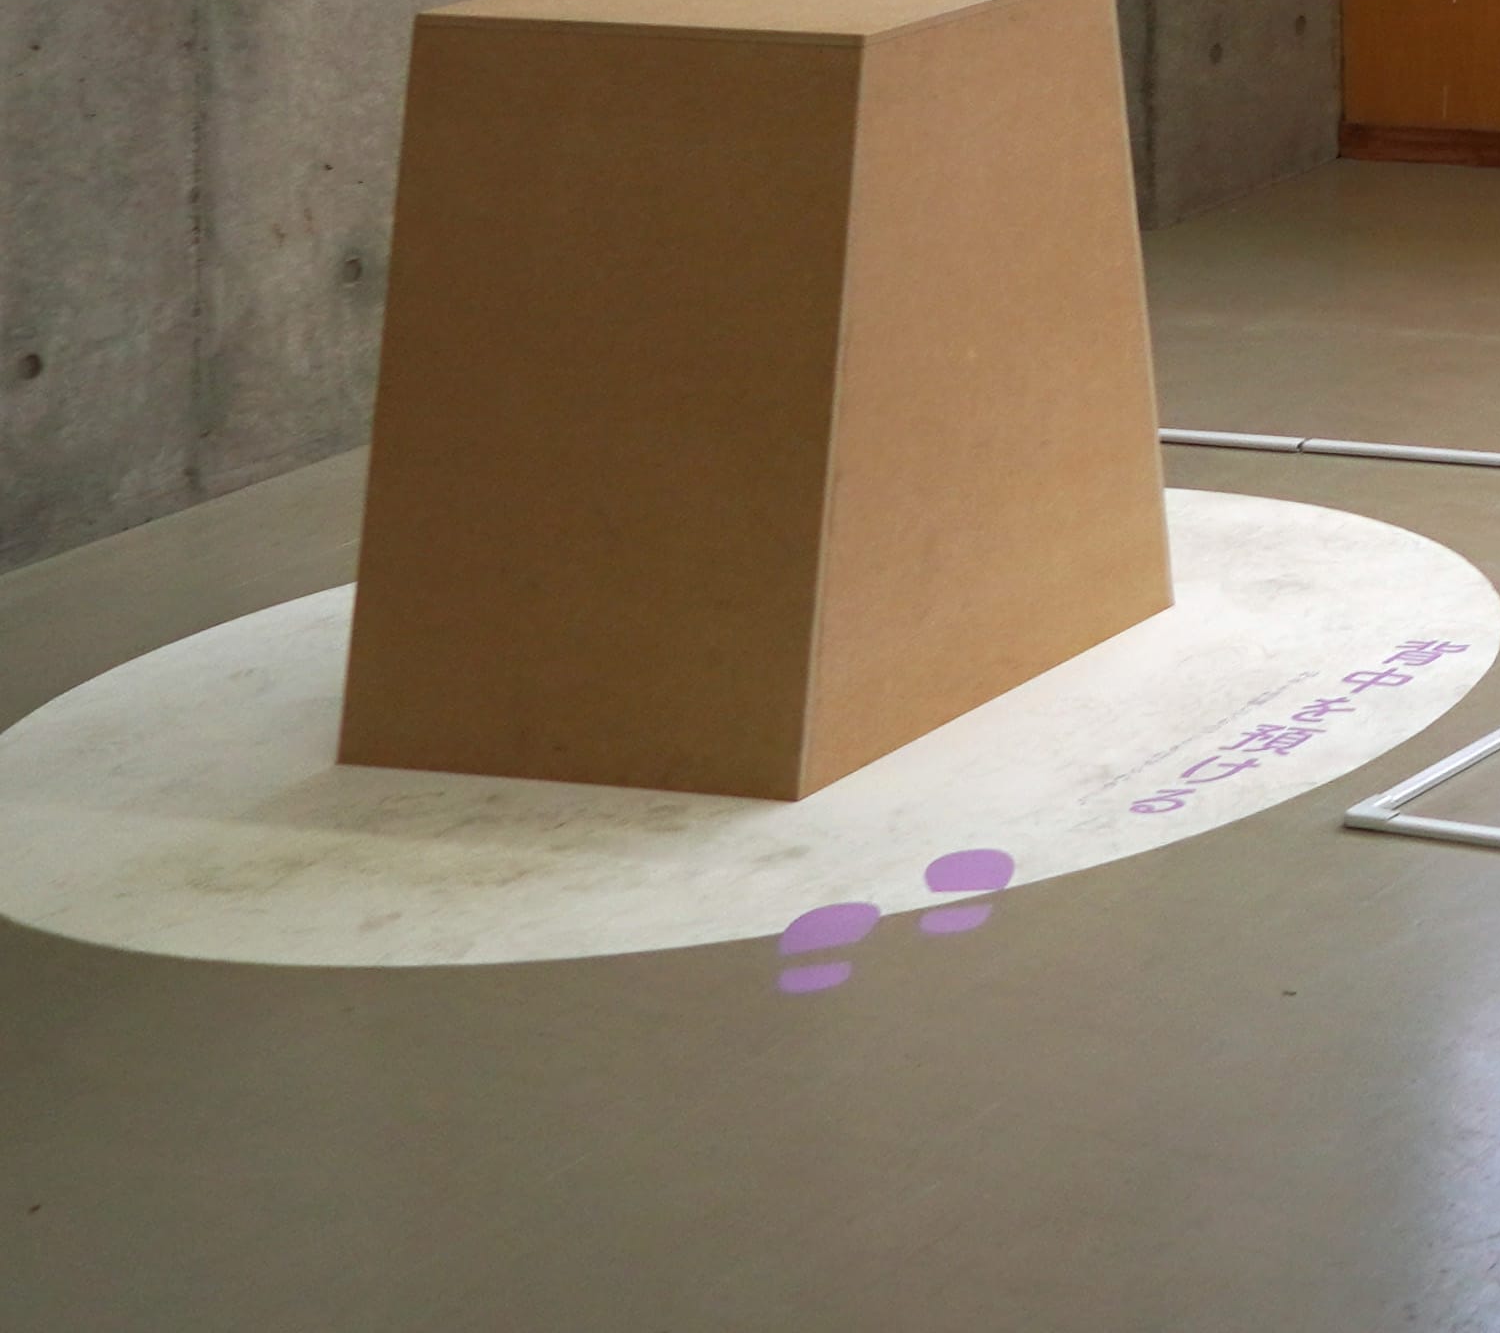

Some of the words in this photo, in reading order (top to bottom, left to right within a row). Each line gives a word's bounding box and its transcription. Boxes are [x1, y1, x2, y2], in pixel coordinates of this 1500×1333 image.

[1128, 639, 1472, 816] 背中を預ける
